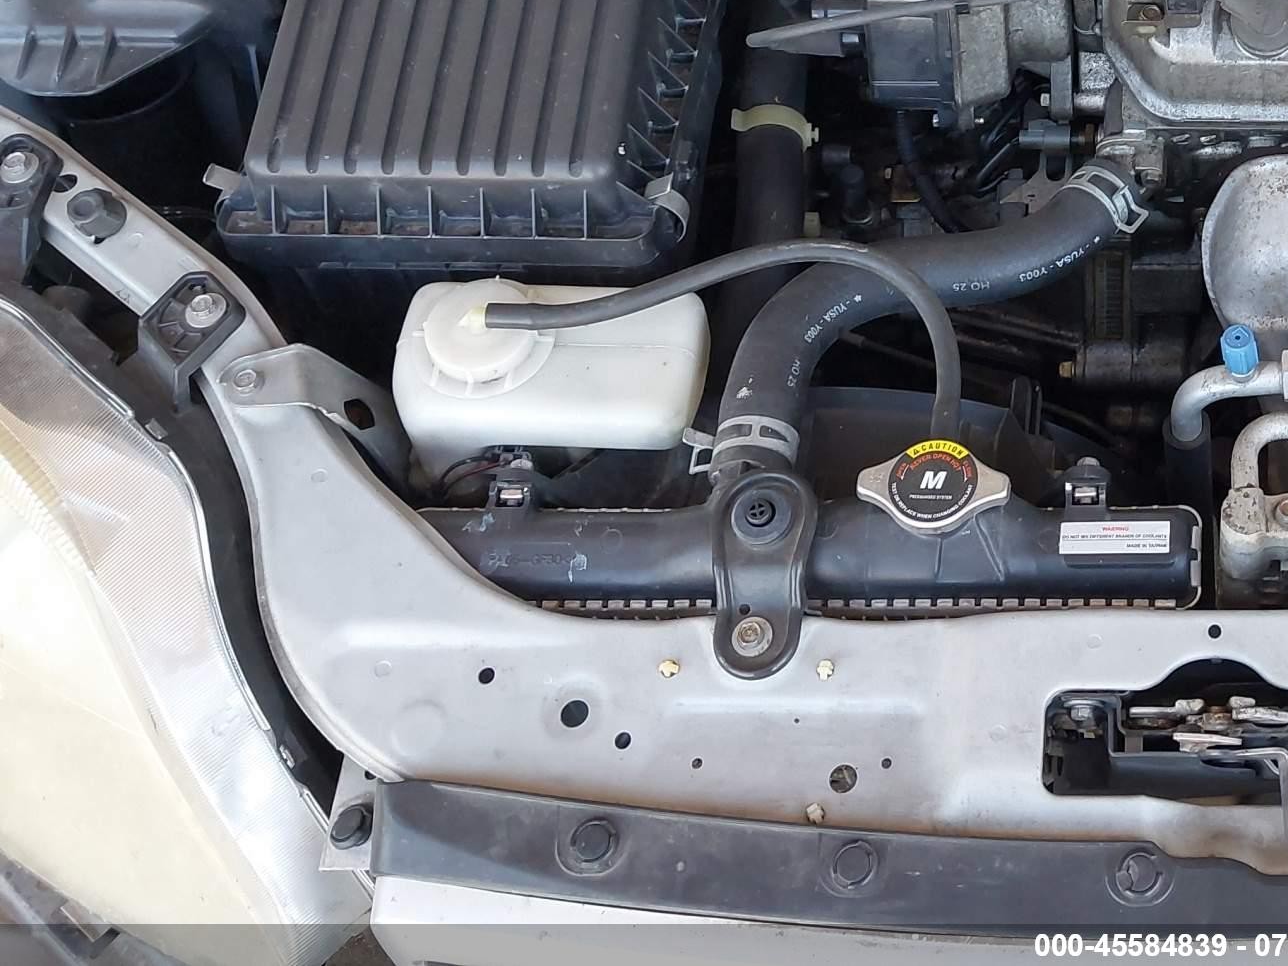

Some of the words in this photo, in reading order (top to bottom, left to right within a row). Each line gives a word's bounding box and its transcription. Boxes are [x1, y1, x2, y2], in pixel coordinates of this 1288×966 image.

[1055, 247, 1085, 268] YUSA
[822, 302, 848, 322] YUSA
[921, 442, 965, 456] CAUTION
[920, 471, 948, 490] M
